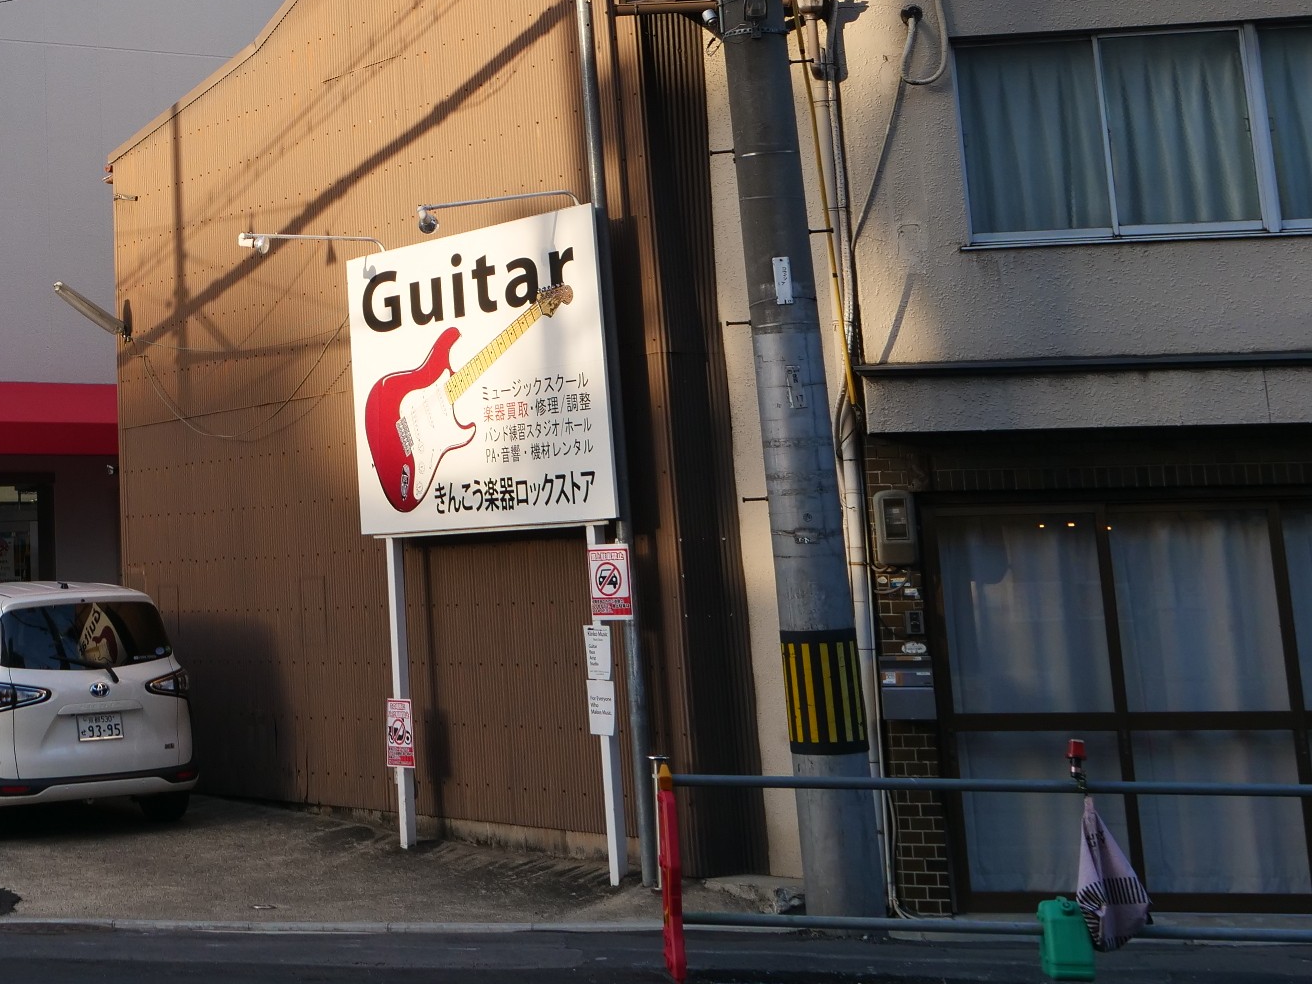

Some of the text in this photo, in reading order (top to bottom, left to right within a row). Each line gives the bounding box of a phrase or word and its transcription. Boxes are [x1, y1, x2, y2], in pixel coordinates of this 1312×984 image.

[362, 245, 574, 333] Guitar
[482, 372, 589, 401] ミュージックスクール
[434, 470, 596, 515] きんこう楽器ロックストア
